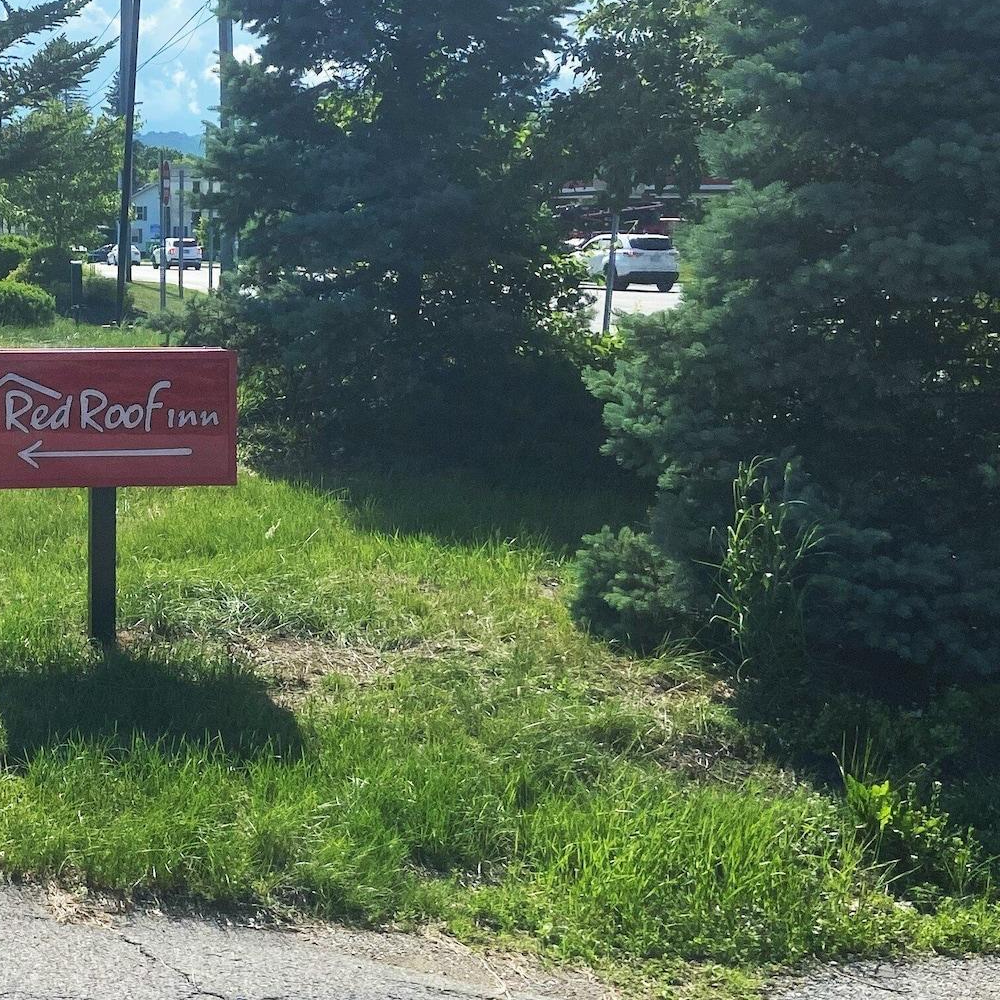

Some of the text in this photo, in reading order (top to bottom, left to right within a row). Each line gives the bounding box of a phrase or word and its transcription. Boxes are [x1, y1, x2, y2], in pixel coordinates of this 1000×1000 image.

[4, 380, 220, 434] Red Roof inn
